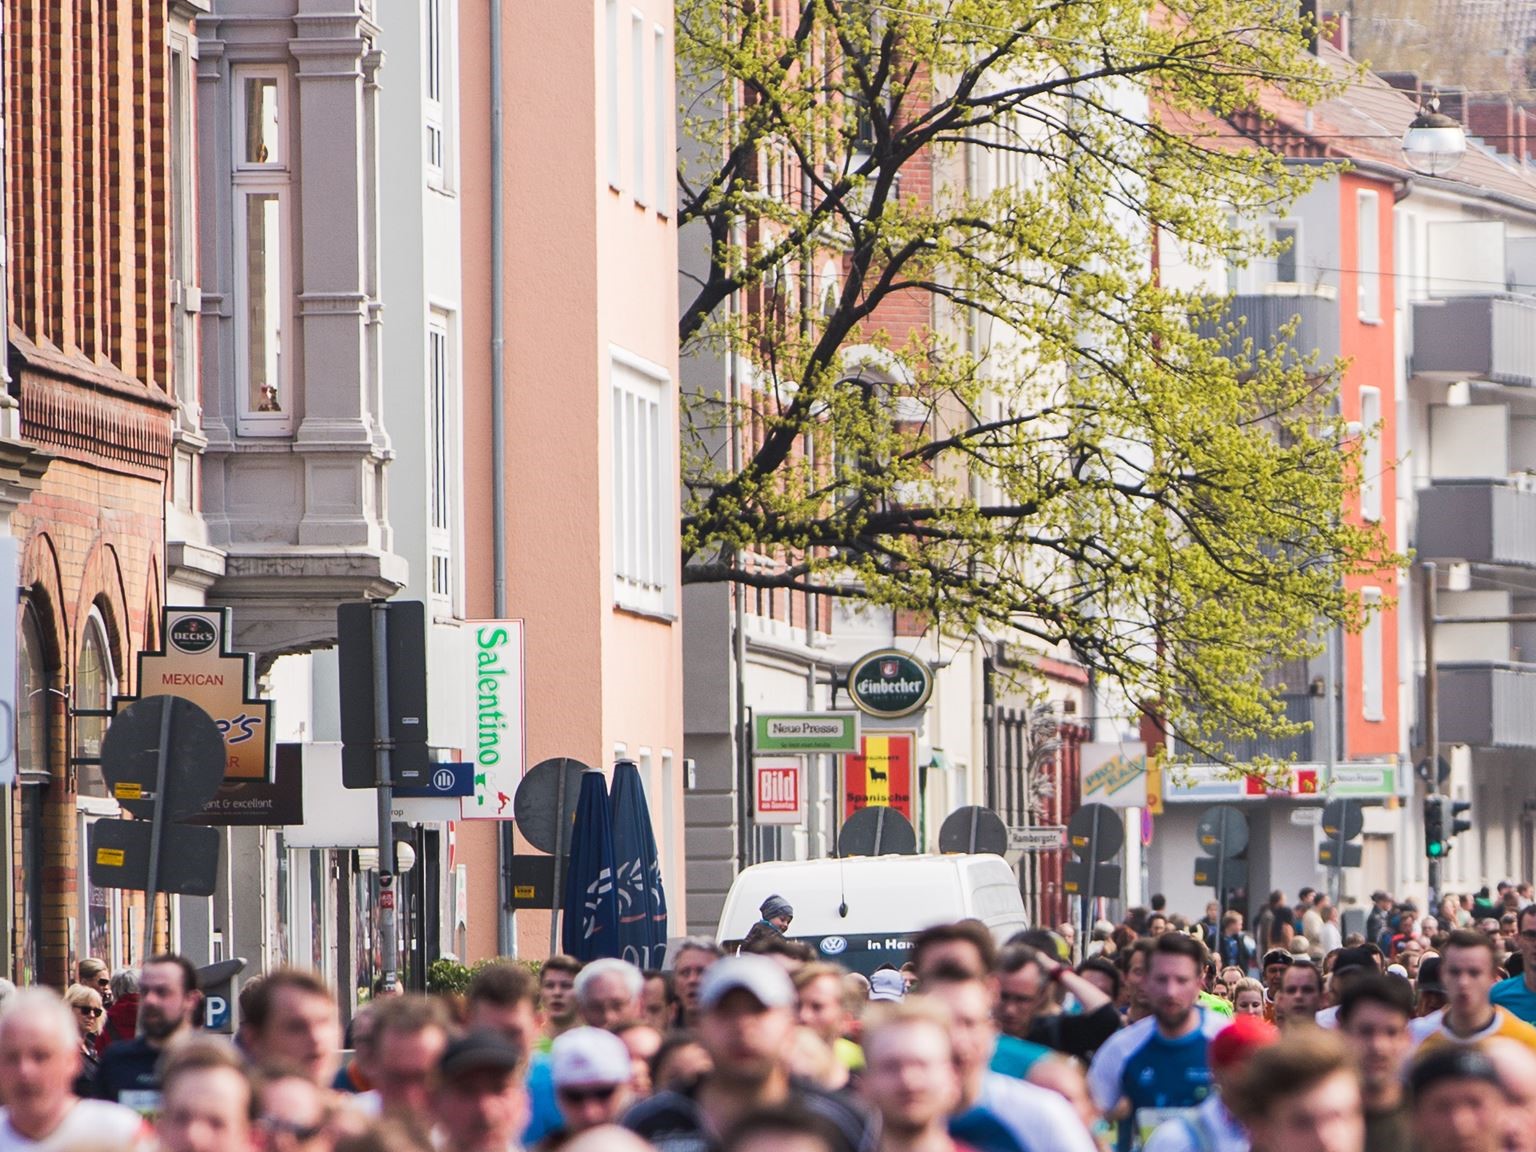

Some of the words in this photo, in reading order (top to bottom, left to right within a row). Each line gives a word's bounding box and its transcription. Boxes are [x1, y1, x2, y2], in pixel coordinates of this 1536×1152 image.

[174, 632, 214, 642] BECK'S
[162, 673, 224, 686] MEXICAN
[477, 626, 509, 766] Salentino
[773, 723, 800, 734] Neue
[803, 722, 839, 734] Presse
[761, 770, 795, 802] Bild
[847, 793, 910, 803] Spanische
[867, 939, 882, 950] in
[884, 938, 917, 950] Han
[206, 997, 226, 1027] P
